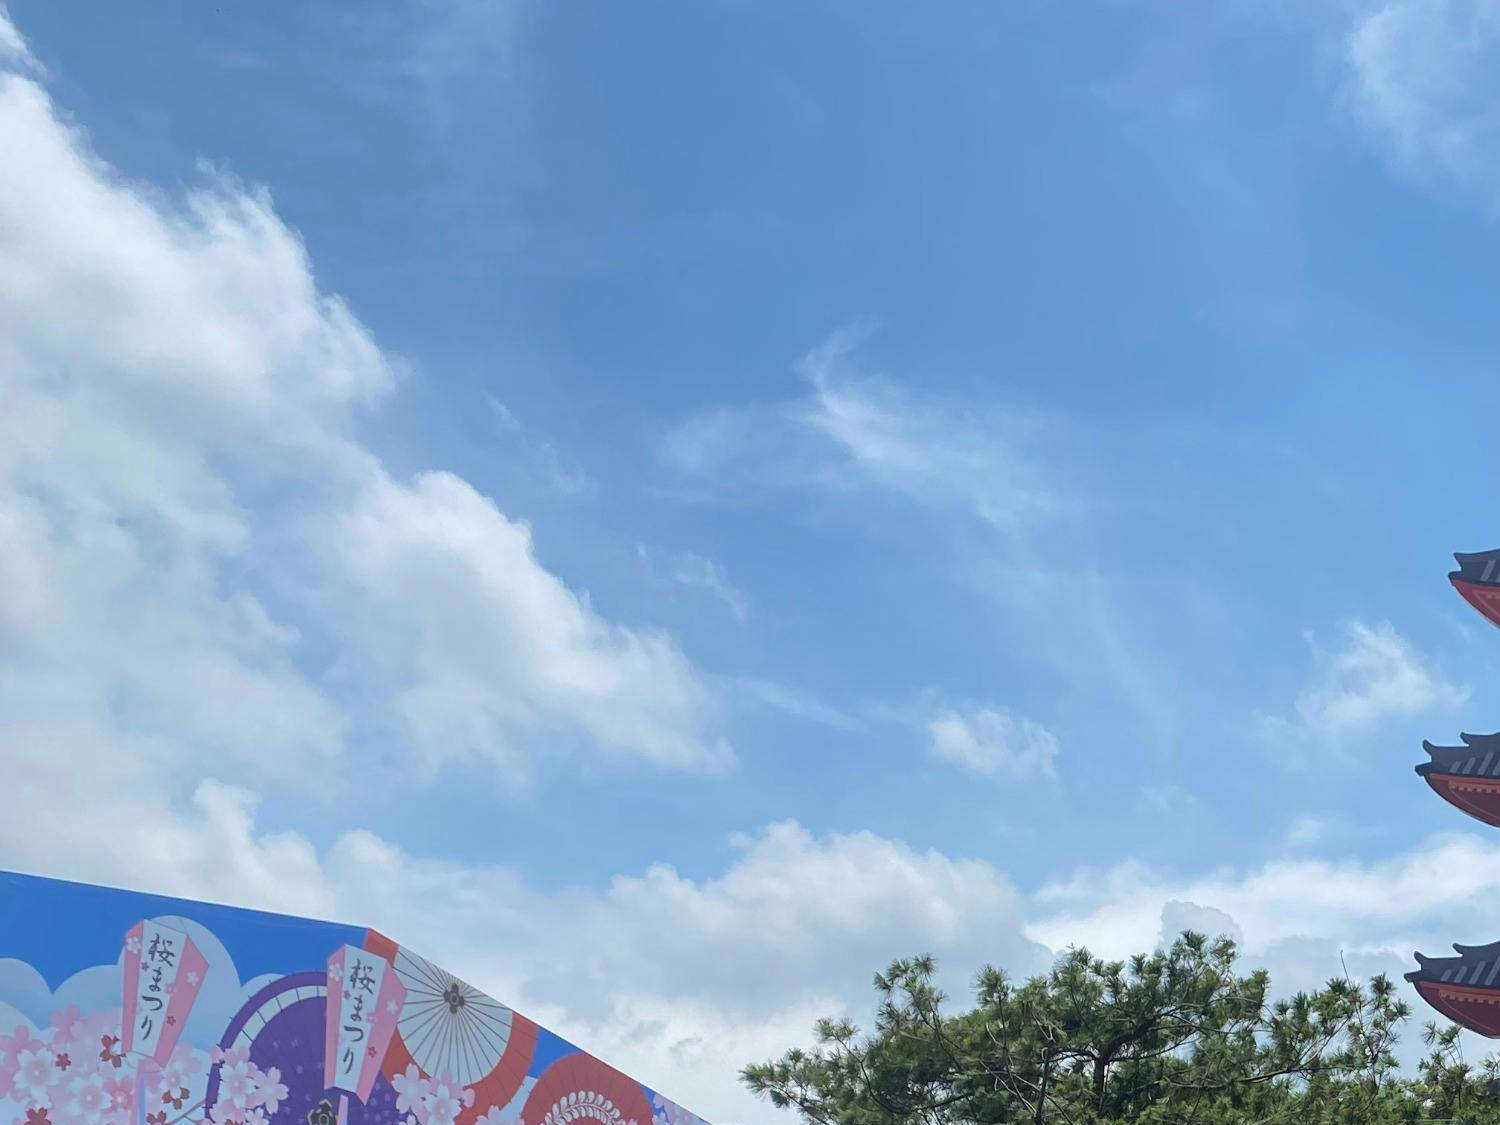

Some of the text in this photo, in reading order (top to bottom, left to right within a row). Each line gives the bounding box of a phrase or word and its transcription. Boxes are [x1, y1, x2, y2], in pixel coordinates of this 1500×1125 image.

[141, 933, 174, 1040] 桜まつり
[343, 958, 375, 1073] 桜まつり
